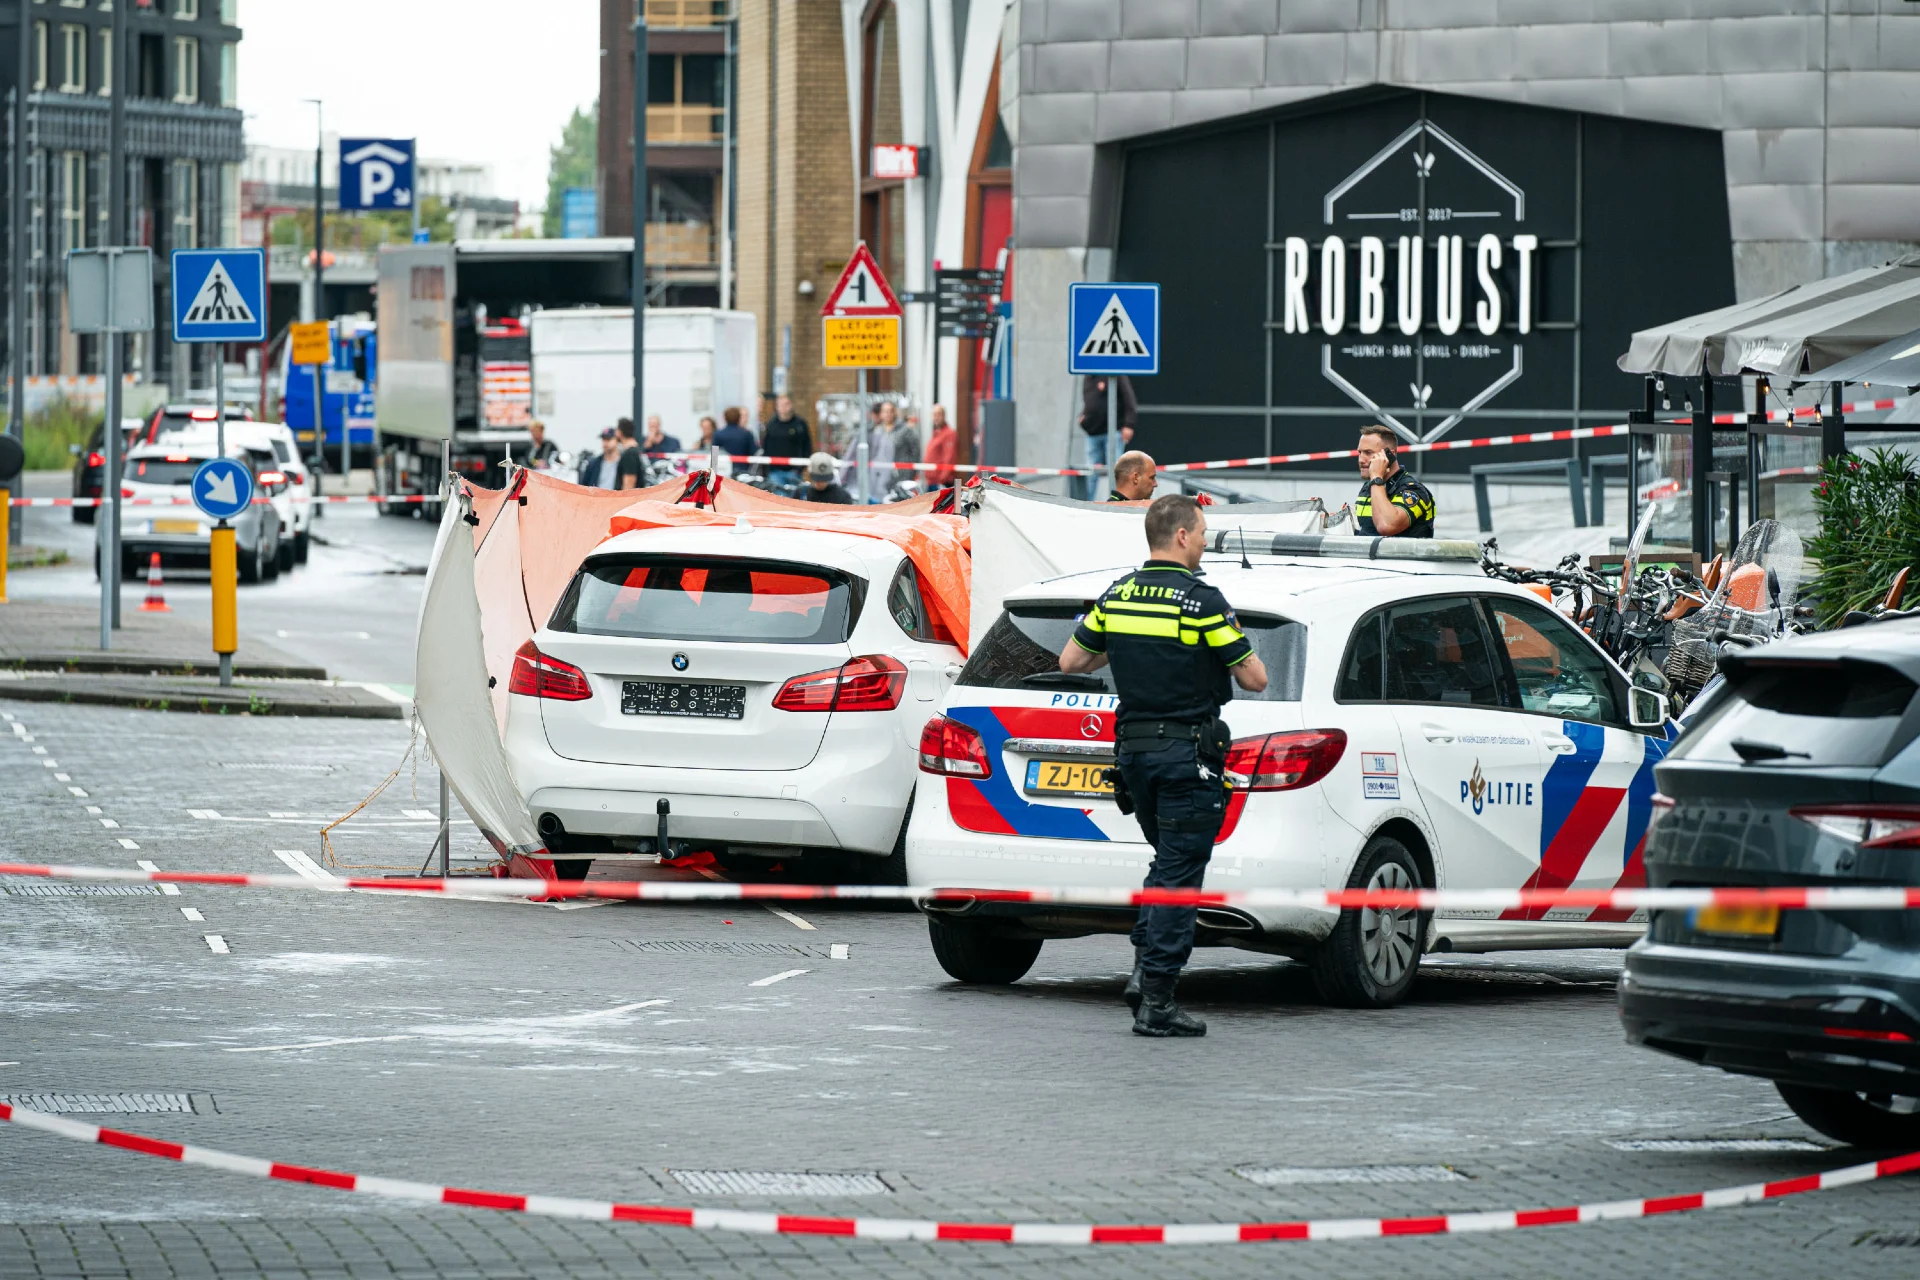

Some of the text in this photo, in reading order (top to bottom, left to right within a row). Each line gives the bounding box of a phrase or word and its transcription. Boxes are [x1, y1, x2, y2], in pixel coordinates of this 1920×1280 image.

[361, 159, 395, 206] P
[1400, 208, 1452, 221] EST. 2017
[1284, 233, 1538, 336] ROBUUST
[1352, 344, 1491, 358] LUNCH BAR GRILL DINER
[1027, 777, 1037, 785] NL
[1460, 779, 1533, 816] POLITIE
